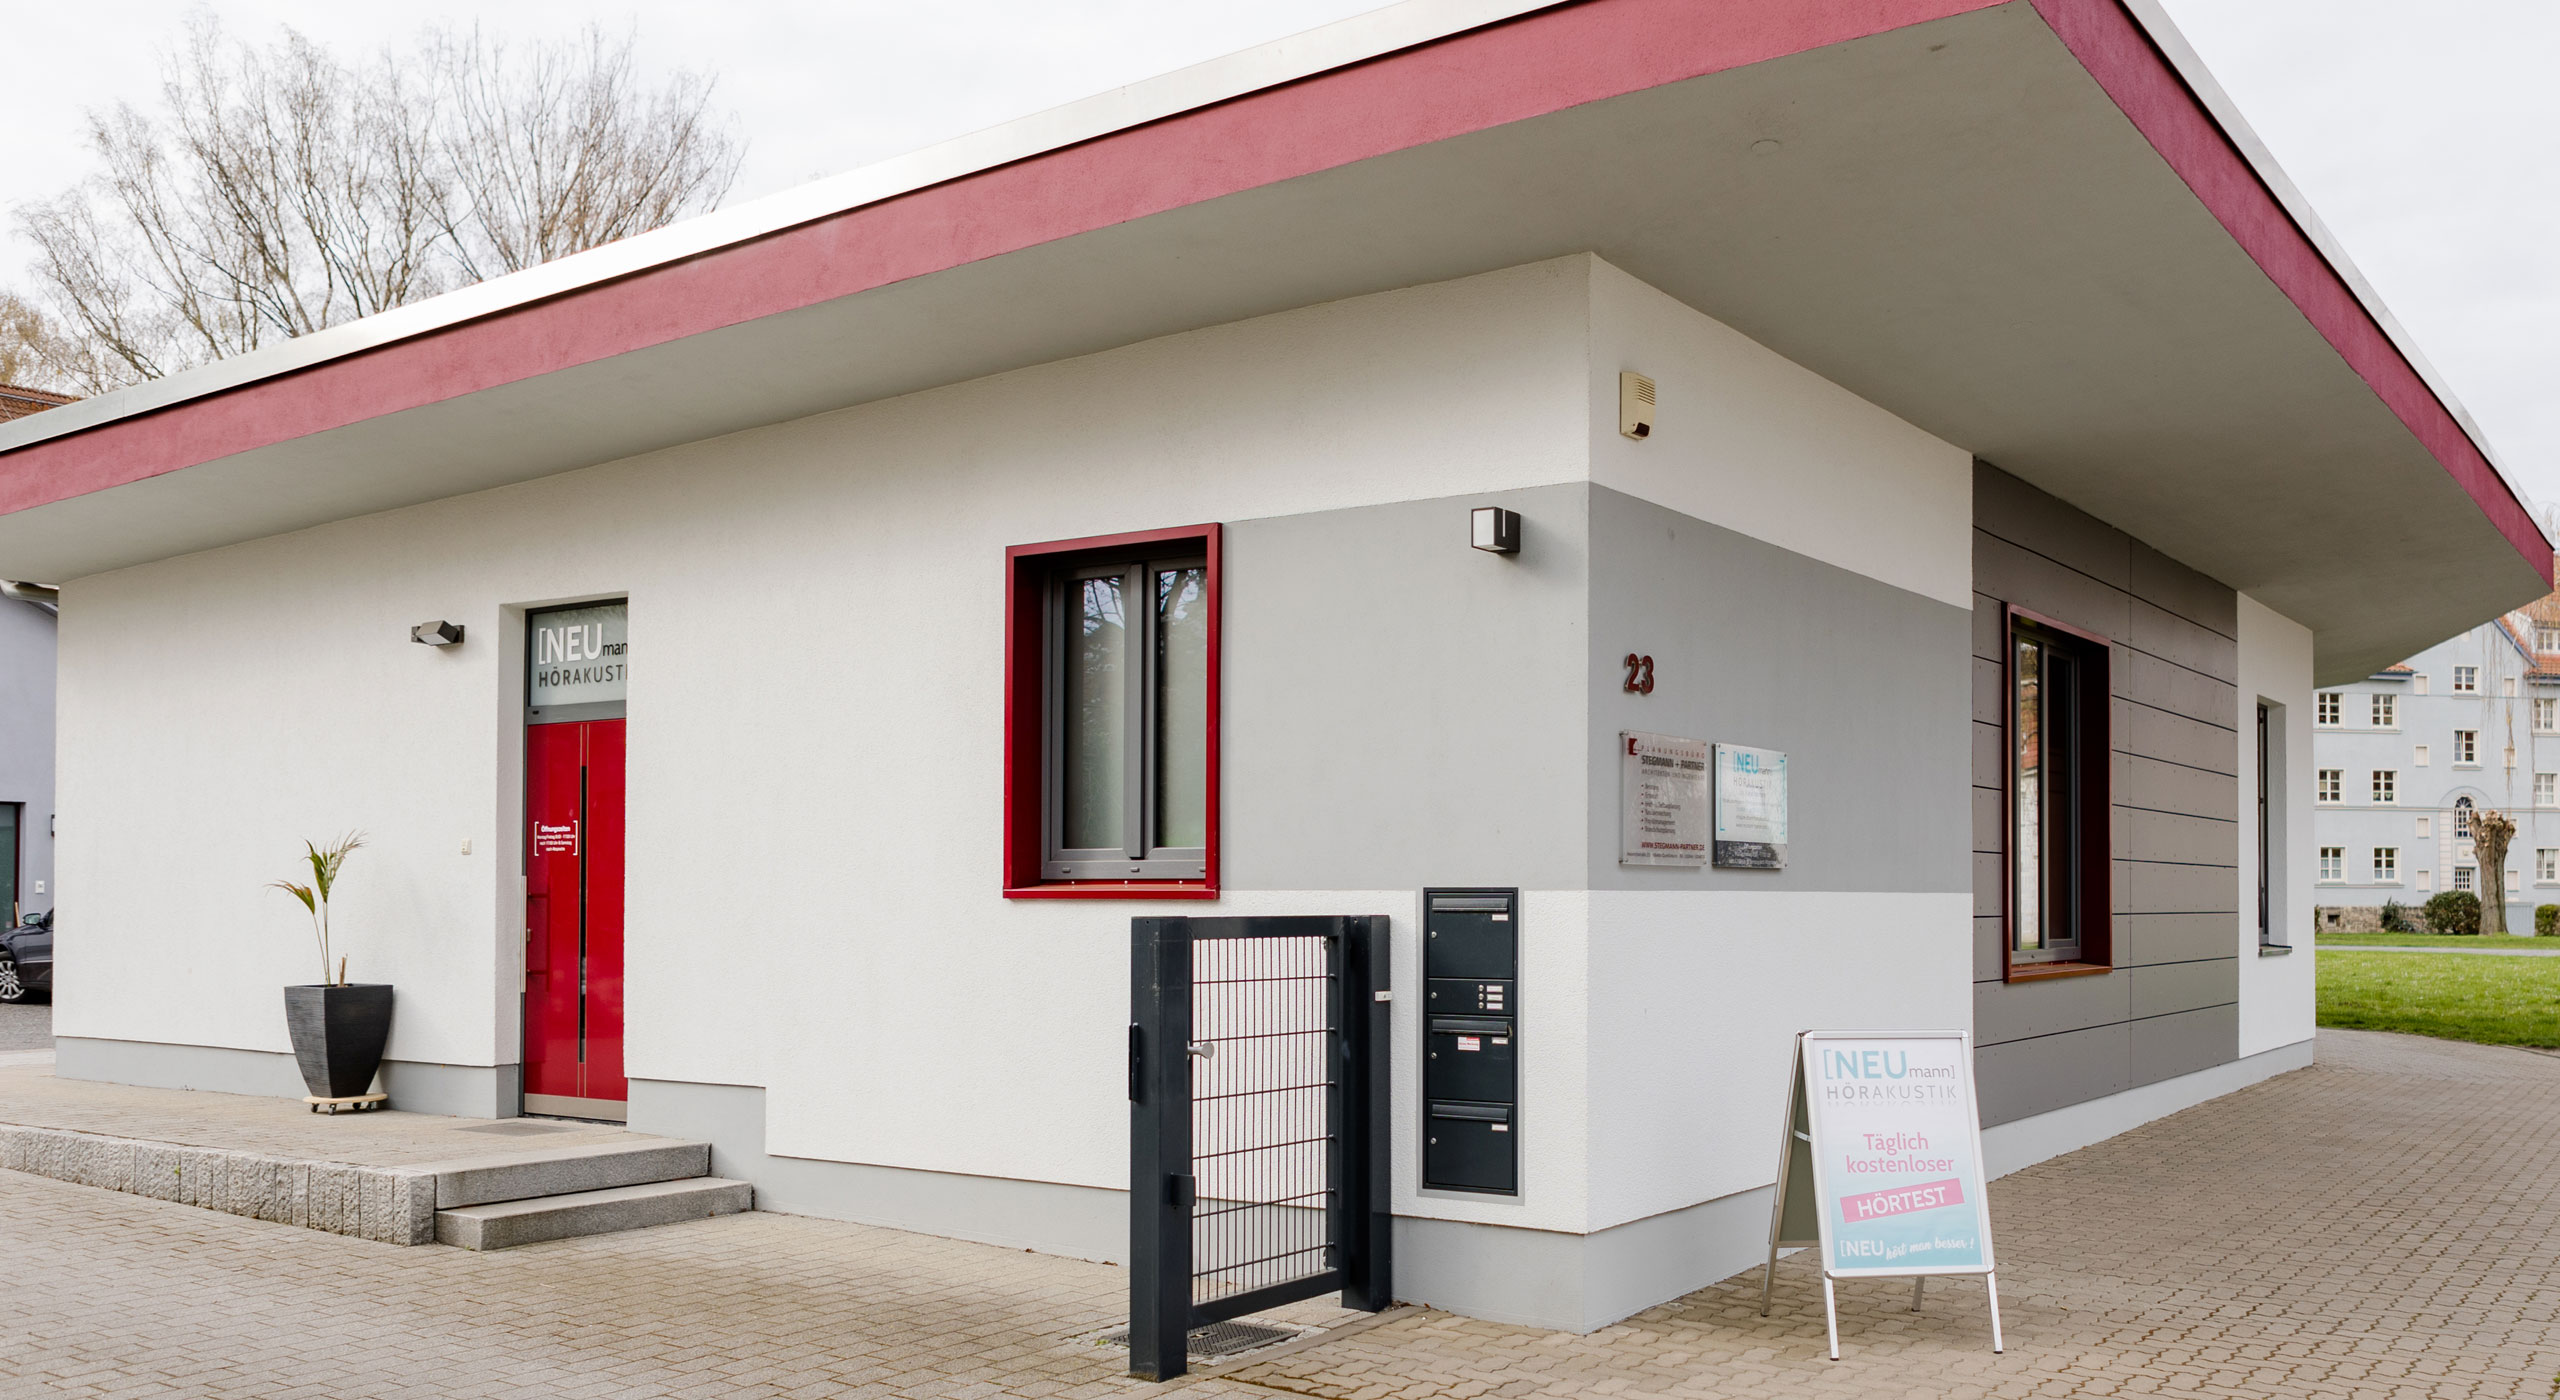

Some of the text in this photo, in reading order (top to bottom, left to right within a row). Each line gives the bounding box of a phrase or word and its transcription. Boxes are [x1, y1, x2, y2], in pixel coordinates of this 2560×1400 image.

[1624, 653, 1655, 695] 23
[1641, 755, 1674, 768] STEGMANN
[1680, 759, 1705, 771] PARTNER
[1826, 1082, 1957, 1100] HÖRAKUSTIK
[1863, 1132, 1929, 1156] Täglich
[1846, 1154, 1955, 1173] kostenloser
[1856, 1186, 1946, 1218] HÖRTEST
